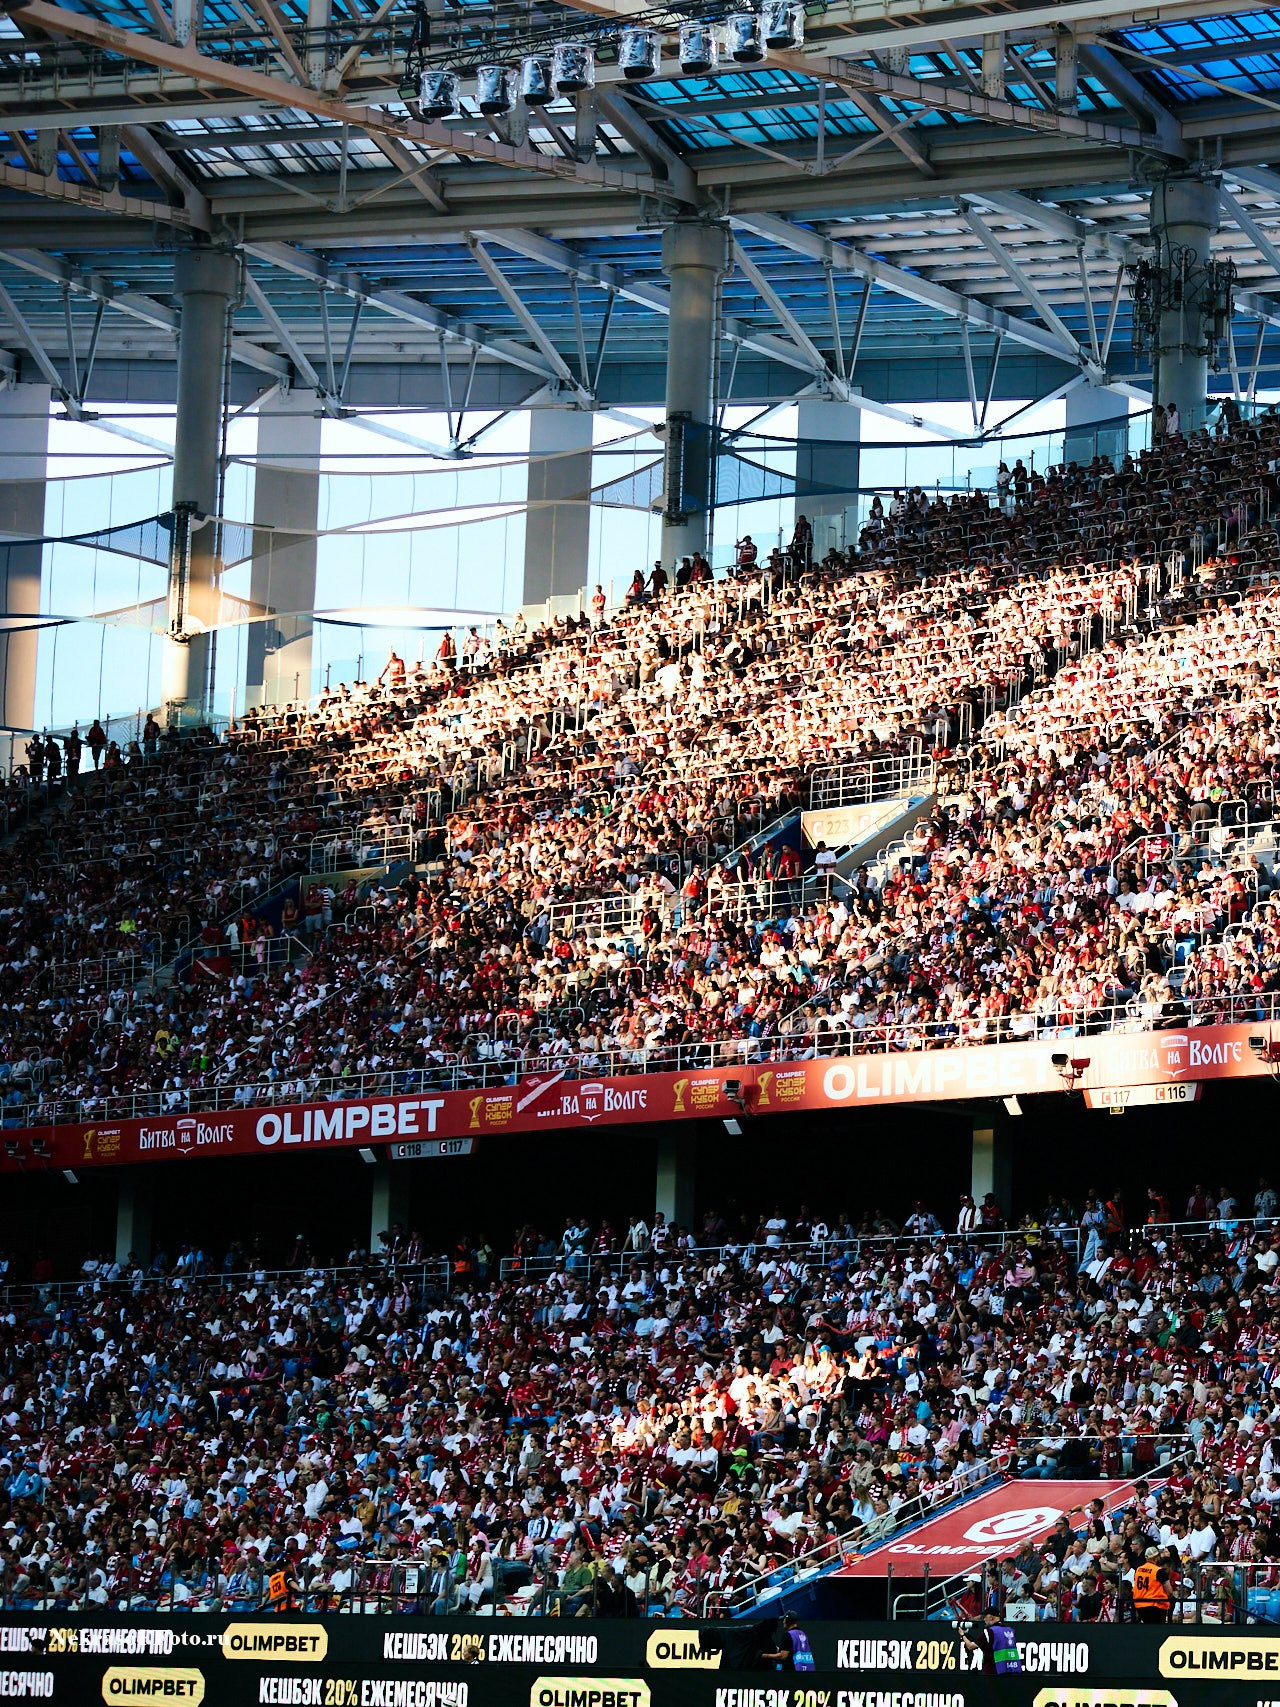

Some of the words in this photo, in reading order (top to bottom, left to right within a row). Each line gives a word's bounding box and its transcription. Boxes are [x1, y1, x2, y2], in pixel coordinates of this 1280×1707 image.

[826, 819, 850, 835] 223
[775, 1070, 806, 1079] OLIMPBET
[823, 1051, 1047, 1100] OLIMPBET
[690, 1078, 719, 1086] OLIMPBET
[776, 1077, 806, 1088] СУПЕР
[691, 1085, 719, 1095] СУПЕР
[775, 1086, 806, 1098] КУБОК
[1113, 1090, 1130, 1104] 117
[1168, 1086, 1186, 1100] 116
[485, 1095, 512, 1103] OLIMPBET
[691, 1094, 719, 1104] КУБОК
[485, 1102, 512, 1112] СУПЕР
[256, 1099, 444, 1146] OLIMPBET
[485, 1111, 512, 1121] КУБОК
[406, 1143, 421, 1156] 118
[449, 1140, 463, 1153] 117
[1136, 1575, 1149, 1591] 64
[230, 1635, 320, 1653] OLIMPBET
[383, 1632, 449, 1660] КЕШБЭК
[488, 1634, 598, 1664] ЕЖЕМЕСЯЧНО
[836, 1639, 914, 1669] КЕШБЭК
[914, 1641, 956, 1670] 20%
[0, 1671, 54, 1698] ЕСЯЧНО
[110, 1678, 197, 1696] OLIMPBET
[259, 1676, 323, 1706] КЕШБЭК
[325, 1679, 358, 1707] 20%
[361, 1679, 469, 1707] ЕЖЕМЕСЯЧНО
[539, 1690, 642, 1707] OLIMPBET
